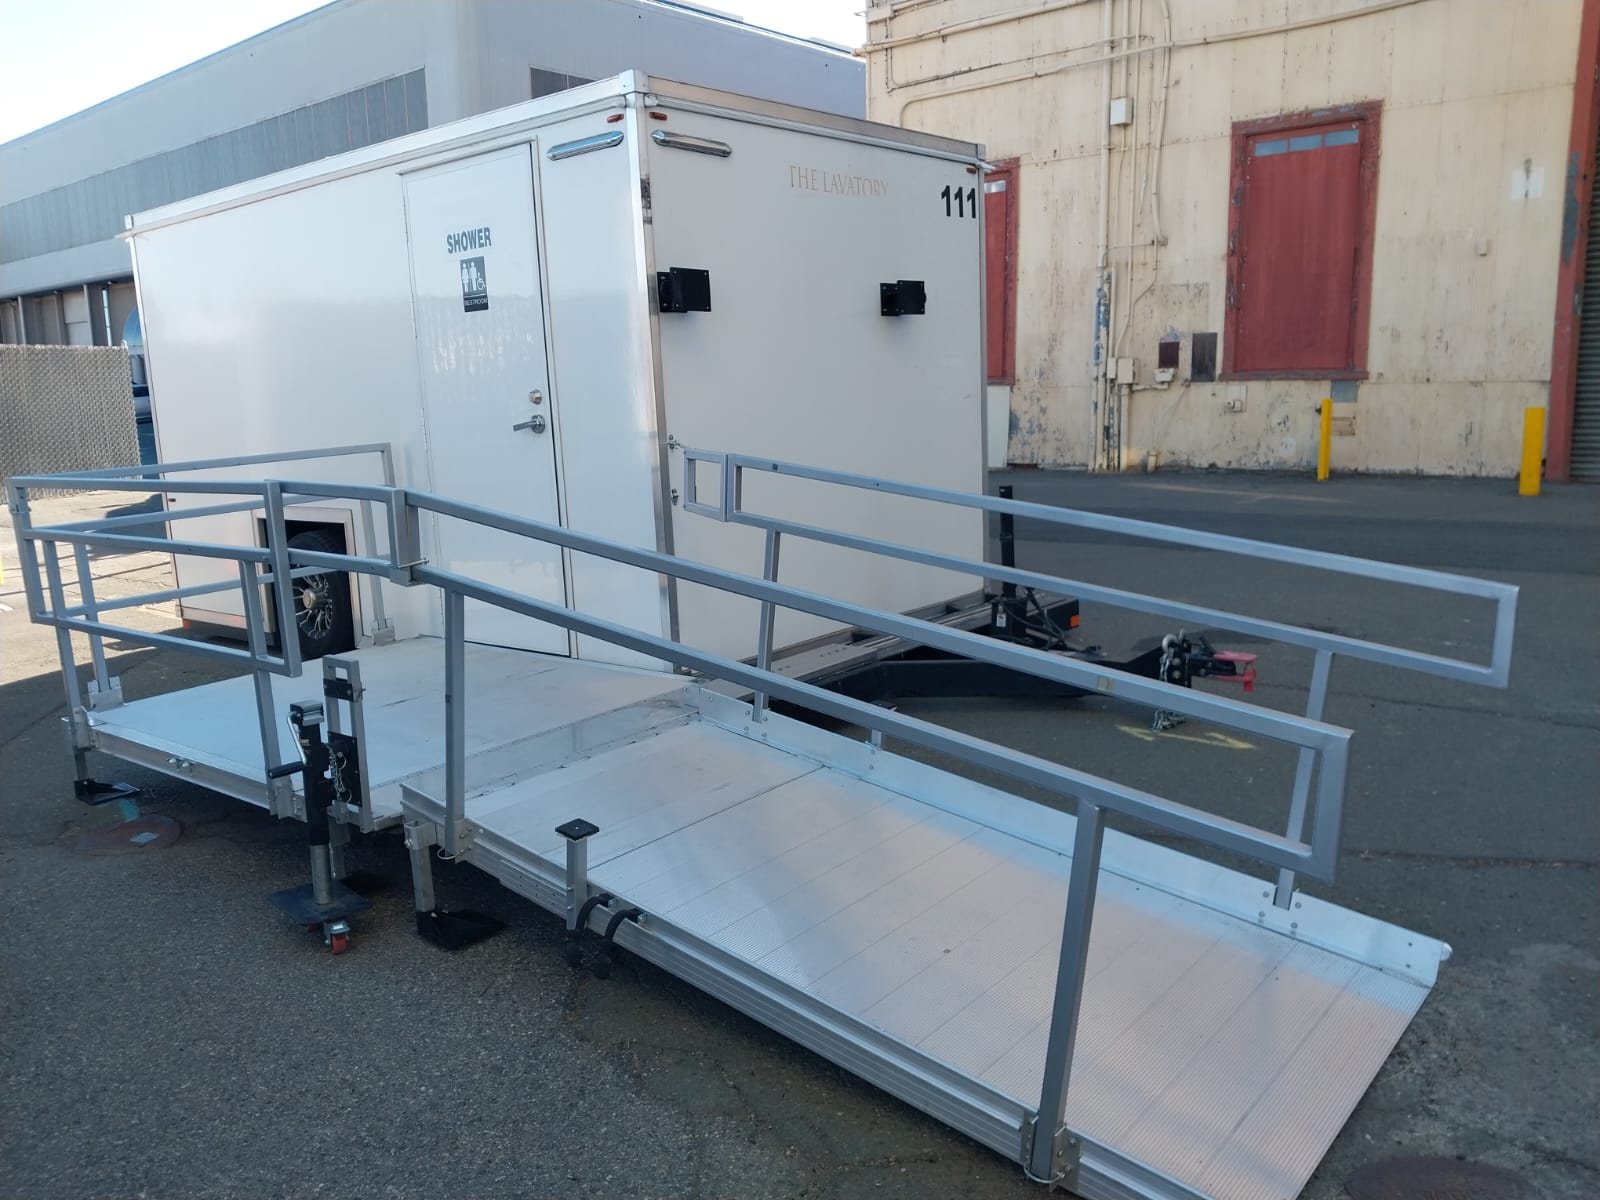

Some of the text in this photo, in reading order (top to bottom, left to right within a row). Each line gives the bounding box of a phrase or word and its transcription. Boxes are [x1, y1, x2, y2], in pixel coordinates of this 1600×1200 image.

[790, 165, 889, 196] THE LAVATORY
[941, 185, 976, 218] 111
[447, 226, 492, 254] SHOWER
